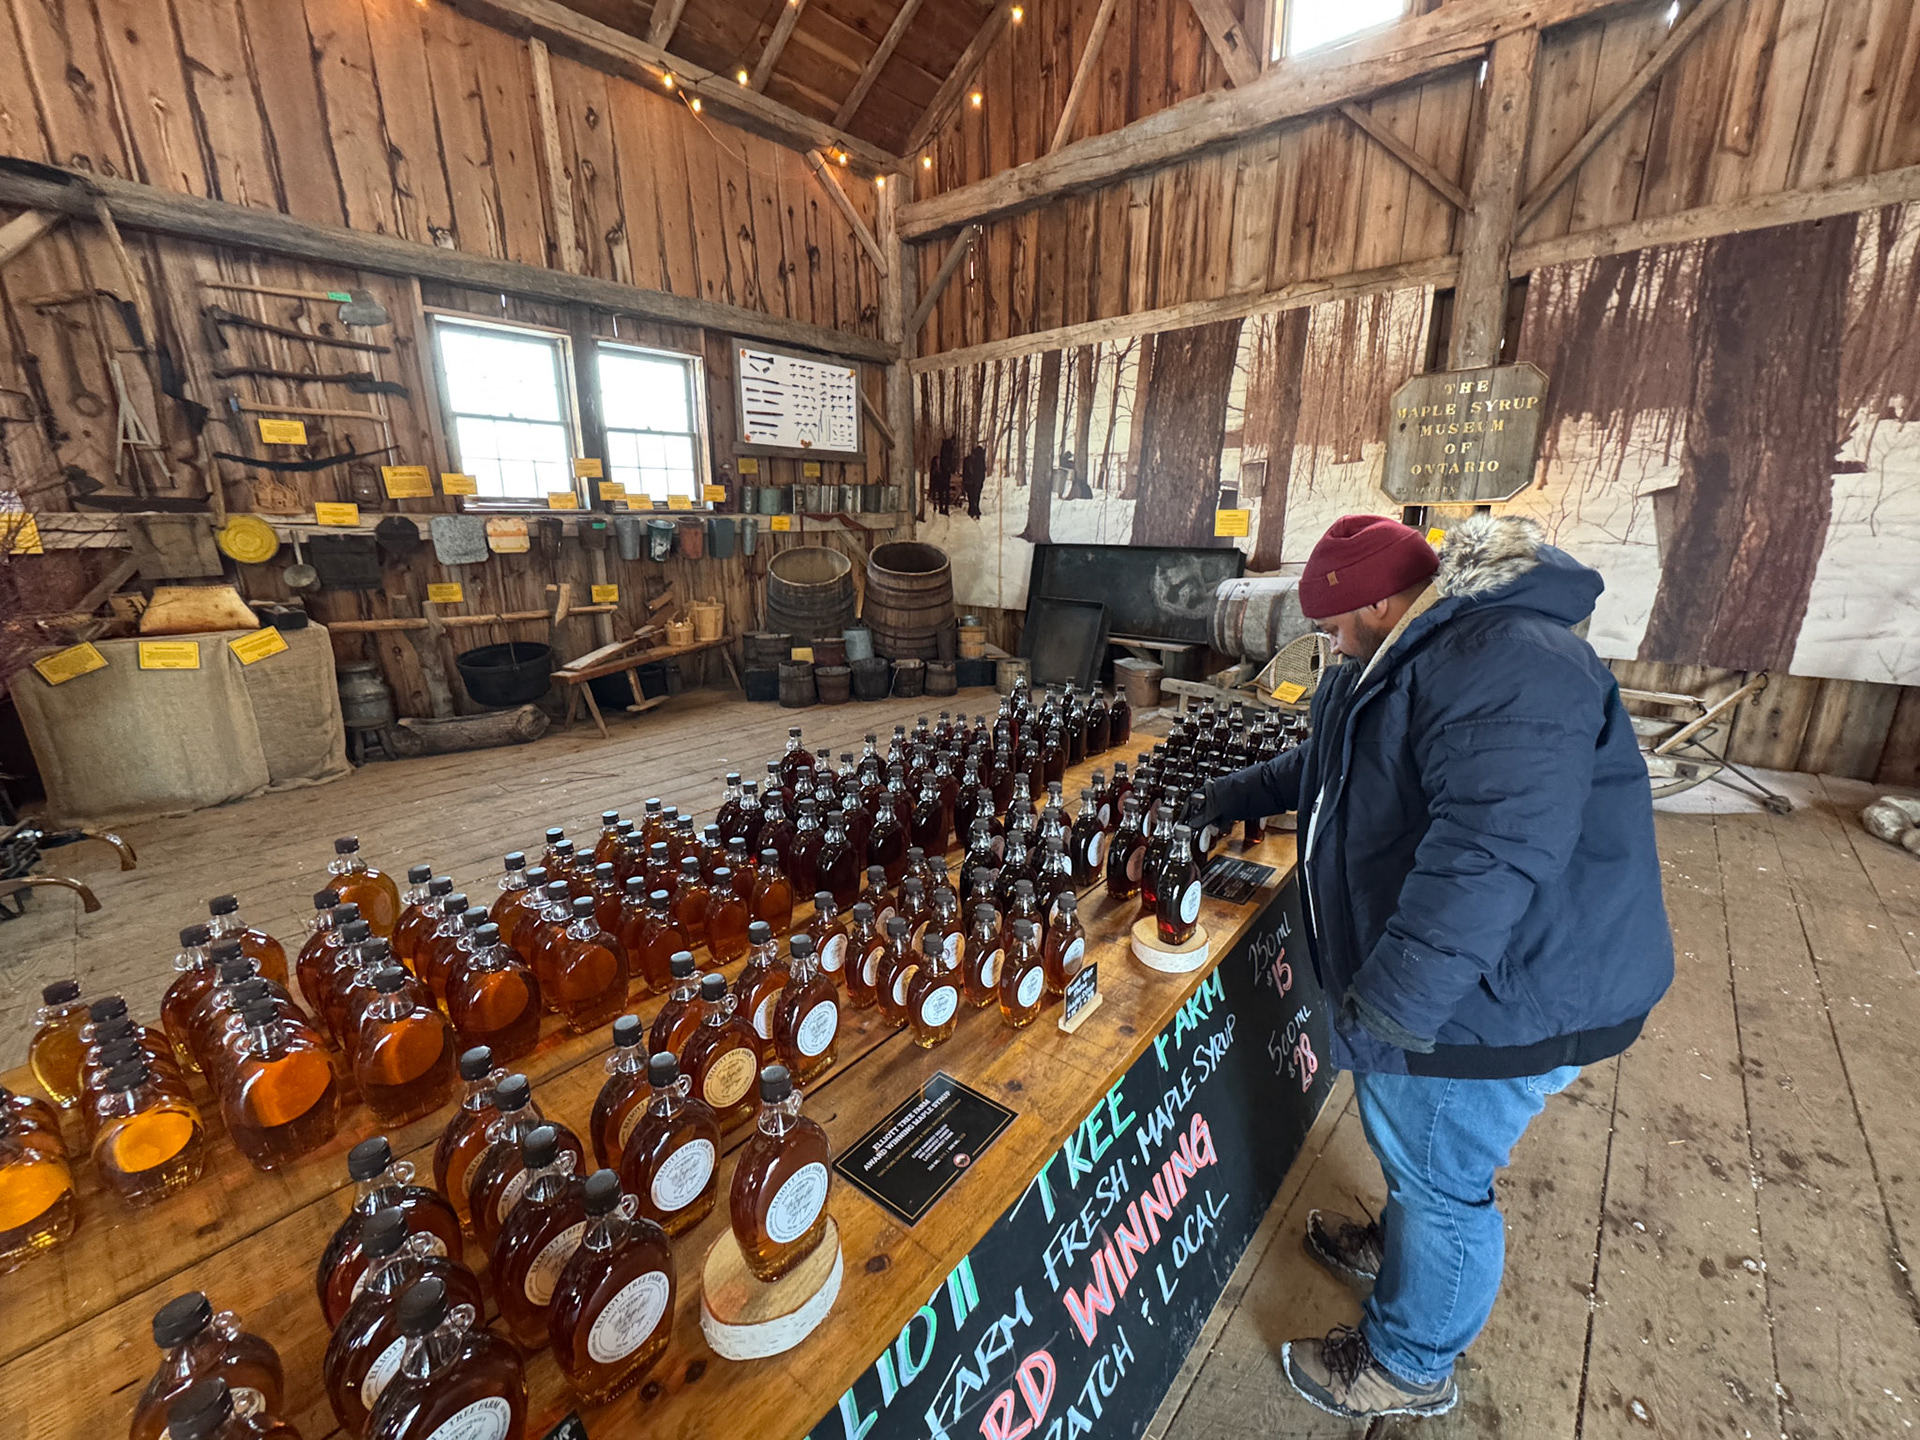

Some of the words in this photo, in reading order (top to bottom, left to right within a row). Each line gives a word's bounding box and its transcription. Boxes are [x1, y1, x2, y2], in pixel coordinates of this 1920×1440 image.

[1444, 380, 1489, 395] THE
[1397, 403, 1457, 419] MAPLE
[1470, 396, 1539, 413] SYRUP
[1420, 419, 1504, 437] MUSEUM
[1410, 460, 1499, 475] ONTARIO
[1444, 442, 1472, 454] OF
[862, 1149, 888, 1171] AWARD
[885, 1125, 915, 1151] WINNING
[912, 1107, 934, 1126] MAPLE
[931, 1091, 952, 1109] SYRUP
[872, 1127, 901, 1151] ELLIOTT
[898, 1114, 916, 1128] TREE
[913, 1100, 931, 1115] FARM
[924, 1285, 1033, 1440] FARM
[1042, 1158, 1130, 1292] FRESH
[1136, 1067, 1197, 1165] MAPLE
[1193, 1013, 1236, 1083] SYRUP
[1063, 1113, 1218, 1347] WINNING
[1156, 1190, 1230, 1305] LOCAL
[595, 1292, 624, 1329] ELLIOTT
[628, 1277, 647, 1291] TREE
[448, 1405, 477, 1427] TREE
[478, 1400, 501, 1410] FARM
